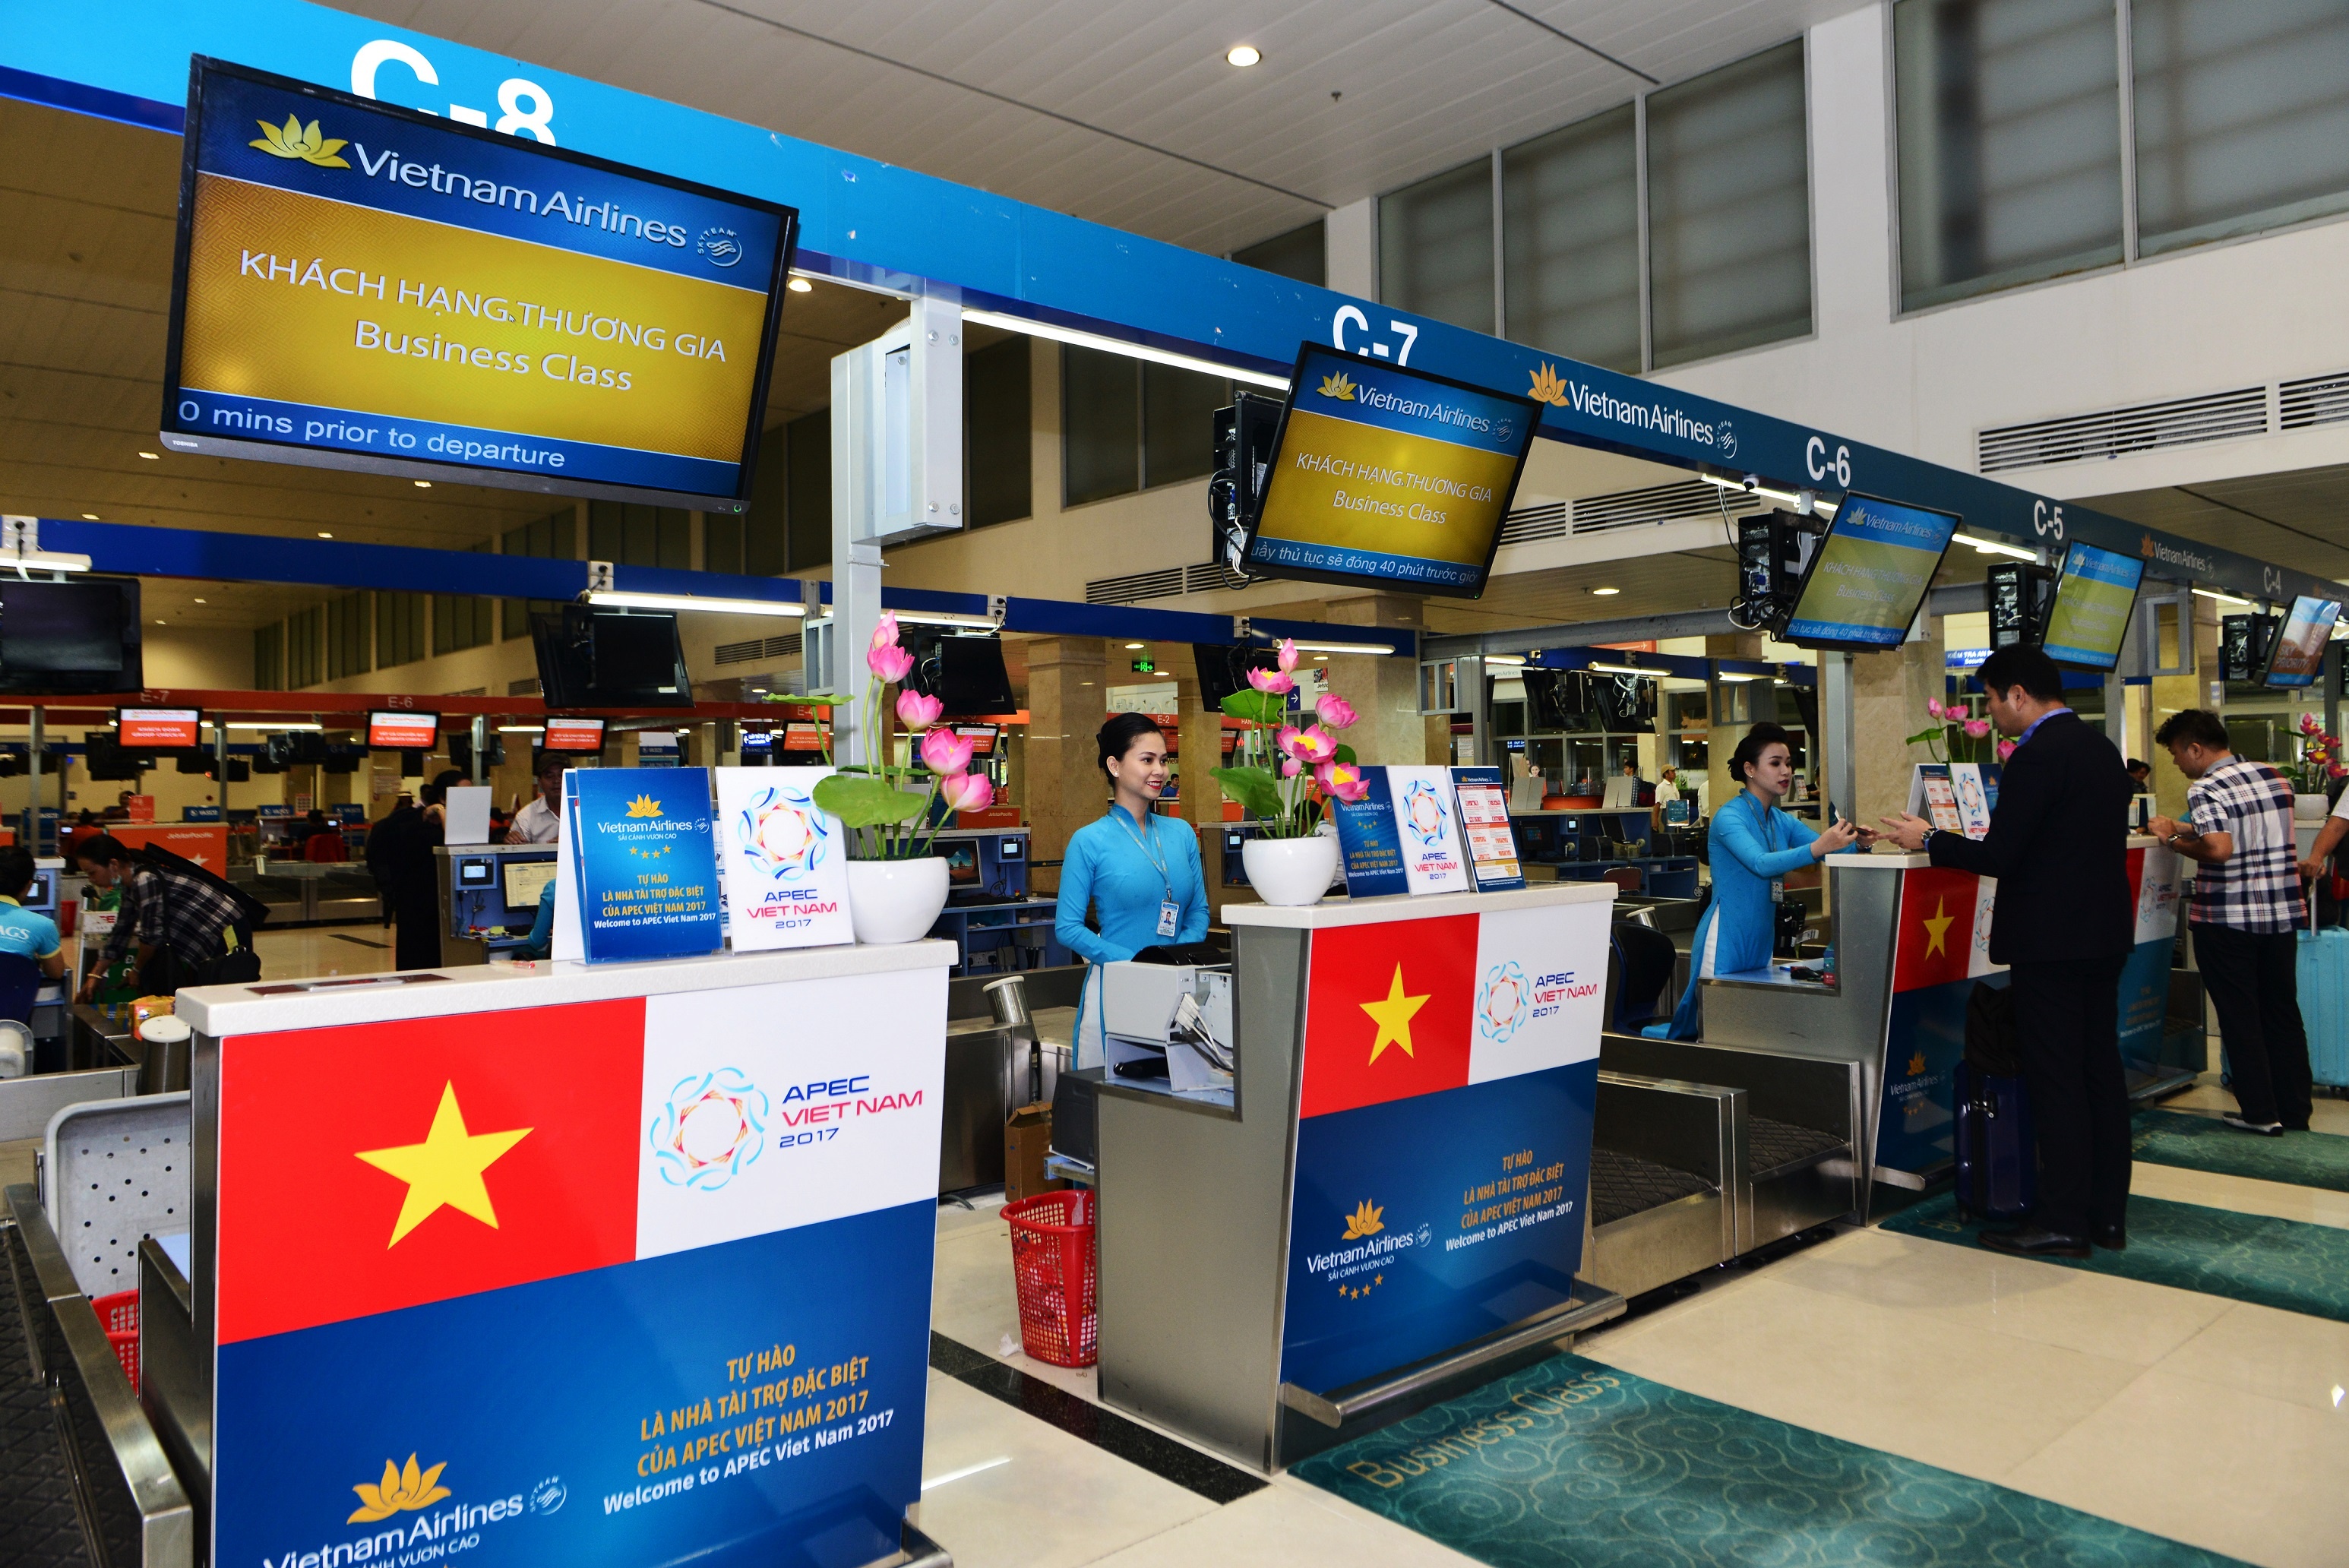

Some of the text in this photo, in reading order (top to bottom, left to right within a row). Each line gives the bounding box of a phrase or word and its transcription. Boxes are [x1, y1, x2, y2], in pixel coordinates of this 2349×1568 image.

[355, 143, 687, 248] Vietnam Airlines
[240, 248, 385, 299] KHÁCH
[516, 300, 666, 351] THƯƠNG
[674, 333, 727, 362] GIA
[1333, 305, 1418, 366] C-7
[355, 320, 632, 391] Business Class
[1358, 384, 1490, 433] Vietnam Airlines
[1570, 381, 1714, 445] Vietnam Airlines
[179, 402, 565, 469] 0 mins prior to departure
[1807, 436, 1851, 488] C-6
[1296, 453, 1354, 477] KHÁCH
[1405, 472, 1466, 498] THƯƠNG
[1469, 485, 1492, 502] GIA
[1333, 491, 1446, 525] Business Class
[2034, 499, 2063, 540] C-5
[1866, 514, 1902, 532] Vietnam
[1279, 545, 1299, 561] thủ
[1304, 550, 1323, 566] tục
[1327, 554, 1342, 566] sẽ
[1346, 556, 1376, 573] đóng
[1380, 560, 1396, 573] 40
[1397, 563, 1424, 577] phút
[1426, 567, 1457, 580] trước
[1459, 570, 1478, 583] giờ
[2154, 542, 2183, 565] Vietnam
[1836, 584, 1873, 599] Business
[2264, 566, 2281, 596] C-4
[2275, 658, 2309, 669] PRIORITY
[388, 696, 413, 708] E-6
[1158, 716, 1170, 724] E-2
[597, 820, 692, 833] Vietnam Airlines
[1415, 861, 1458, 872] VIET NAM
[1422, 852, 1447, 861] APEC
[602, 884, 704, 902] LÀ NHÀ TÀI TRỢ ĐẶC BIỆT
[637, 872, 669, 887] TỰ HÀO
[602, 901, 706, 917] CỦA APEC VIỆT NAM 2017
[747, 902, 837, 918] VIET NAM
[764, 889, 818, 903] APEC
[594, 919, 630, 928] Welcome
[643, 916, 662, 925] APEC
[663, 915, 679, 924] Viet
[681, 914, 698, 922] Nam
[700, 912, 716, 922] 2017
[776, 918, 811, 929] 2017
[1534, 984, 1597, 1004] VIET NAM
[1535, 972, 1575, 988] APEC
[1532, 1006, 1560, 1017] 2017
[782, 1076, 870, 1104] APEC
[782, 1089, 923, 1127] VIET NAM
[779, 1127, 839, 1149] 2017
[1503, 1149, 1533, 1173] TỰ HÀO
[1464, 1162, 1564, 1205] LÀ NHÀ TÀI TRỢ ĐẶC BIỆT
[1481, 1203, 1502, 1224] APEC
[1503, 1197, 1522, 1218] VIỆT
[1522, 1192, 1541, 1210] NAM
[1543, 1186, 1563, 1203] 2017
[1446, 1200, 1573, 1252] Welcome to APEC Viet Nam 2017
[1307, 1232, 1414, 1274] Vietnam Airlines
[1381, 1255, 1395, 1266] CAO
[727, 1344, 796, 1383] TỰ HÀO
[640, 1356, 870, 1441] LÀ NHÀ TÀI TRỢ ĐẶC BIỆT
[637, 1389, 869, 1478] CỦA APEC VIỆT NAM 2017
[1346, 1371, 1620, 1489] Business Class
[602, 1408, 895, 1516] Welcome to APEC Viet Nam 2017
[263, 1494, 523, 1568] Vietnam Airlines
[448, 1532, 480, 1554] CAO
